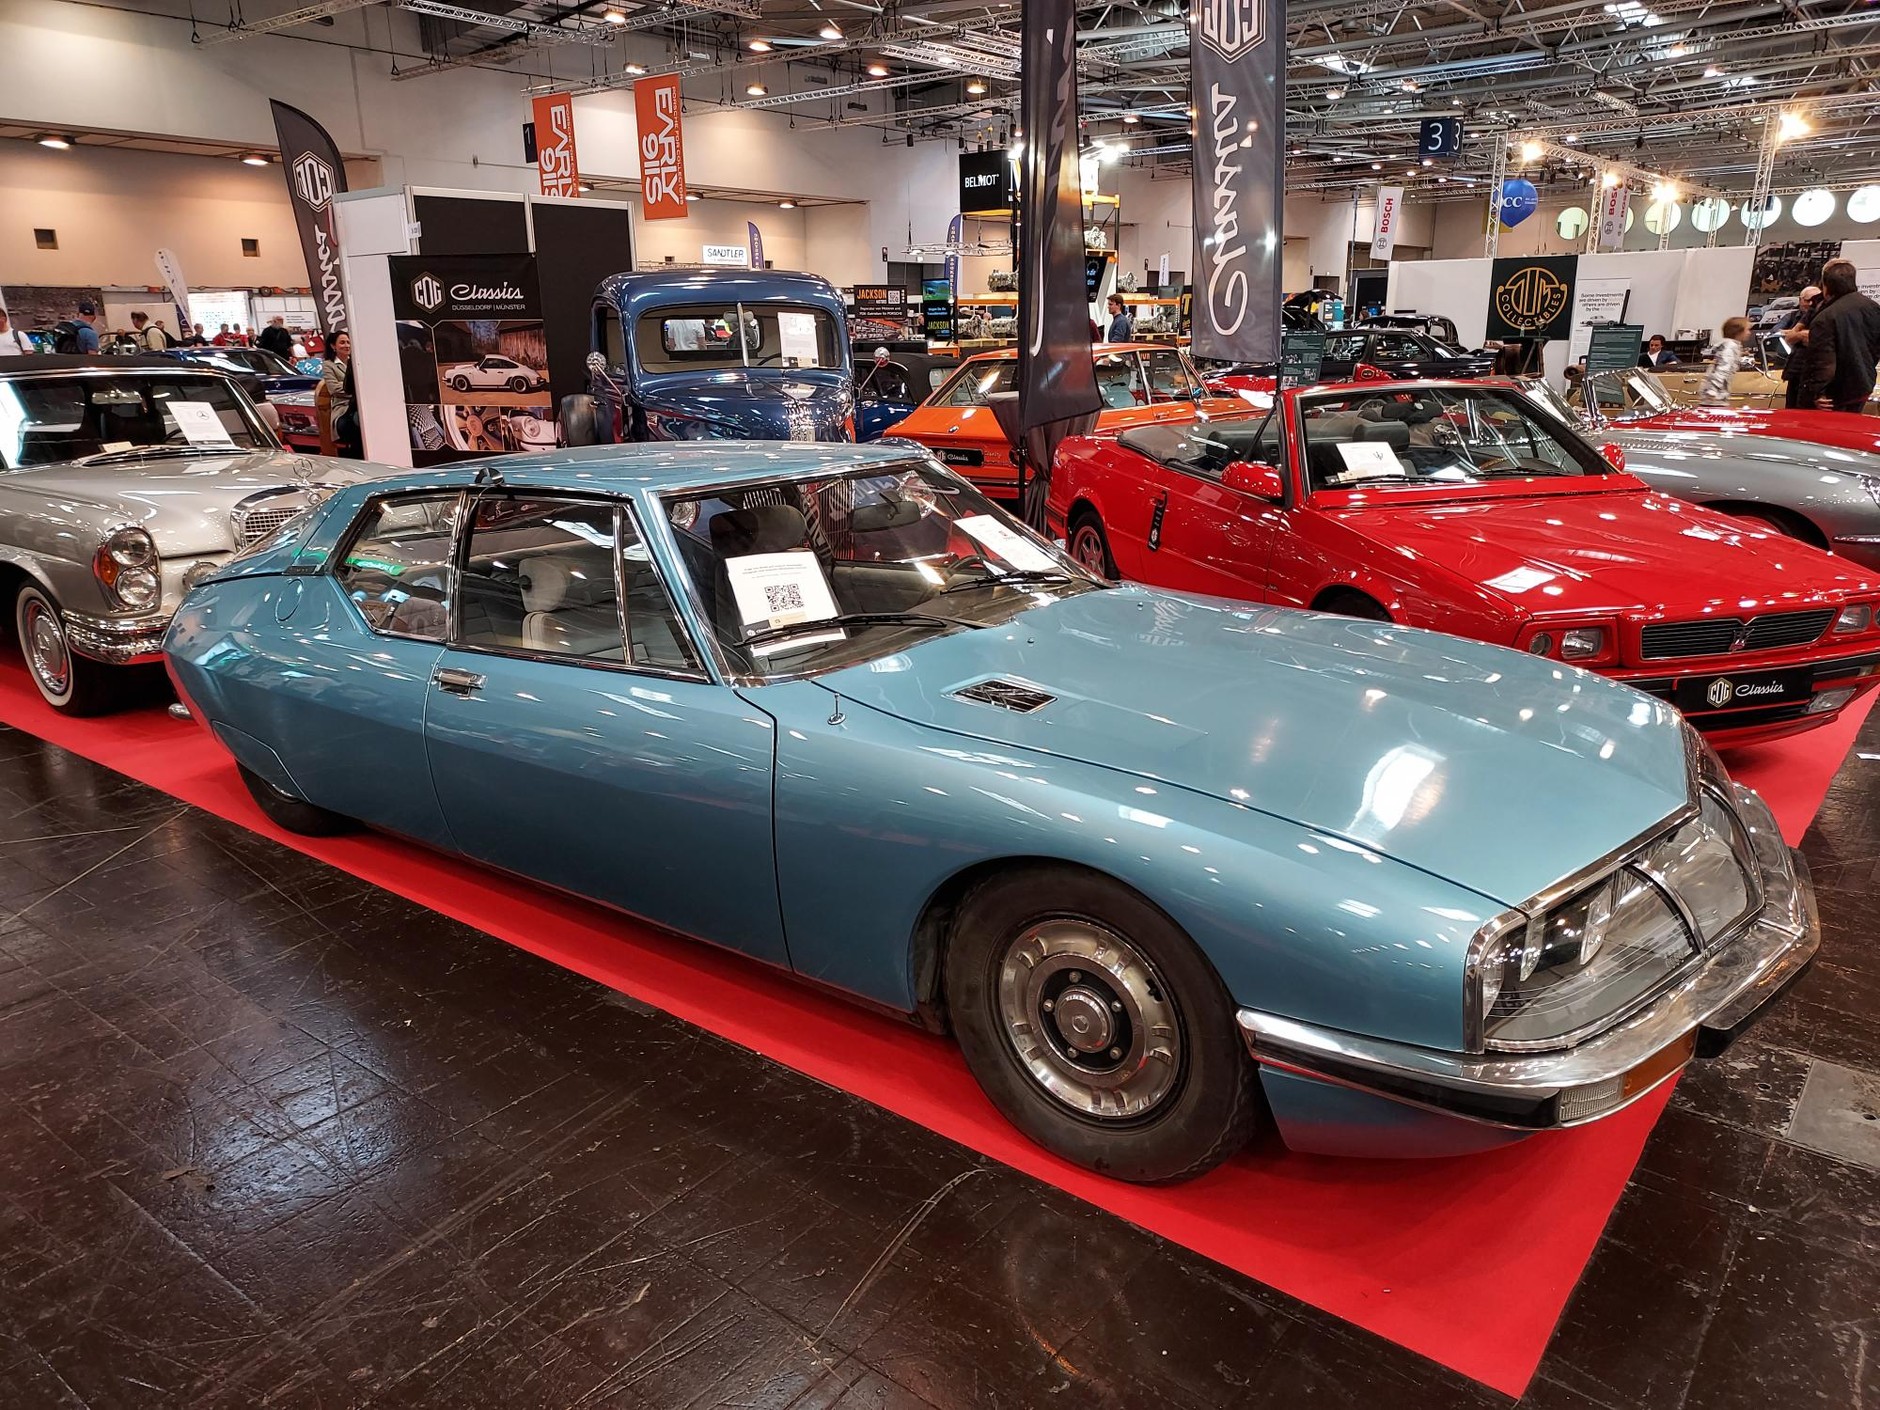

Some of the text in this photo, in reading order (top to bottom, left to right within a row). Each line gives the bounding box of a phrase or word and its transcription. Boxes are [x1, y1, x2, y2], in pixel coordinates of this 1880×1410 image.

[655, 87, 680, 205] EARLY
[1428, 122, 1443, 151] 3
[1453, 121, 1461, 151] 3
[1501, 196, 1523, 208] CC
[1381, 198, 1394, 233] BOSCH
[414, 276, 524, 309] COG Classics
[857, 289, 887, 299] JACKSON
[496, 303, 526, 311] MÜNSTER
[927, 321, 949, 330] JACKSON
[1709, 681, 1785, 704] COG Classics
